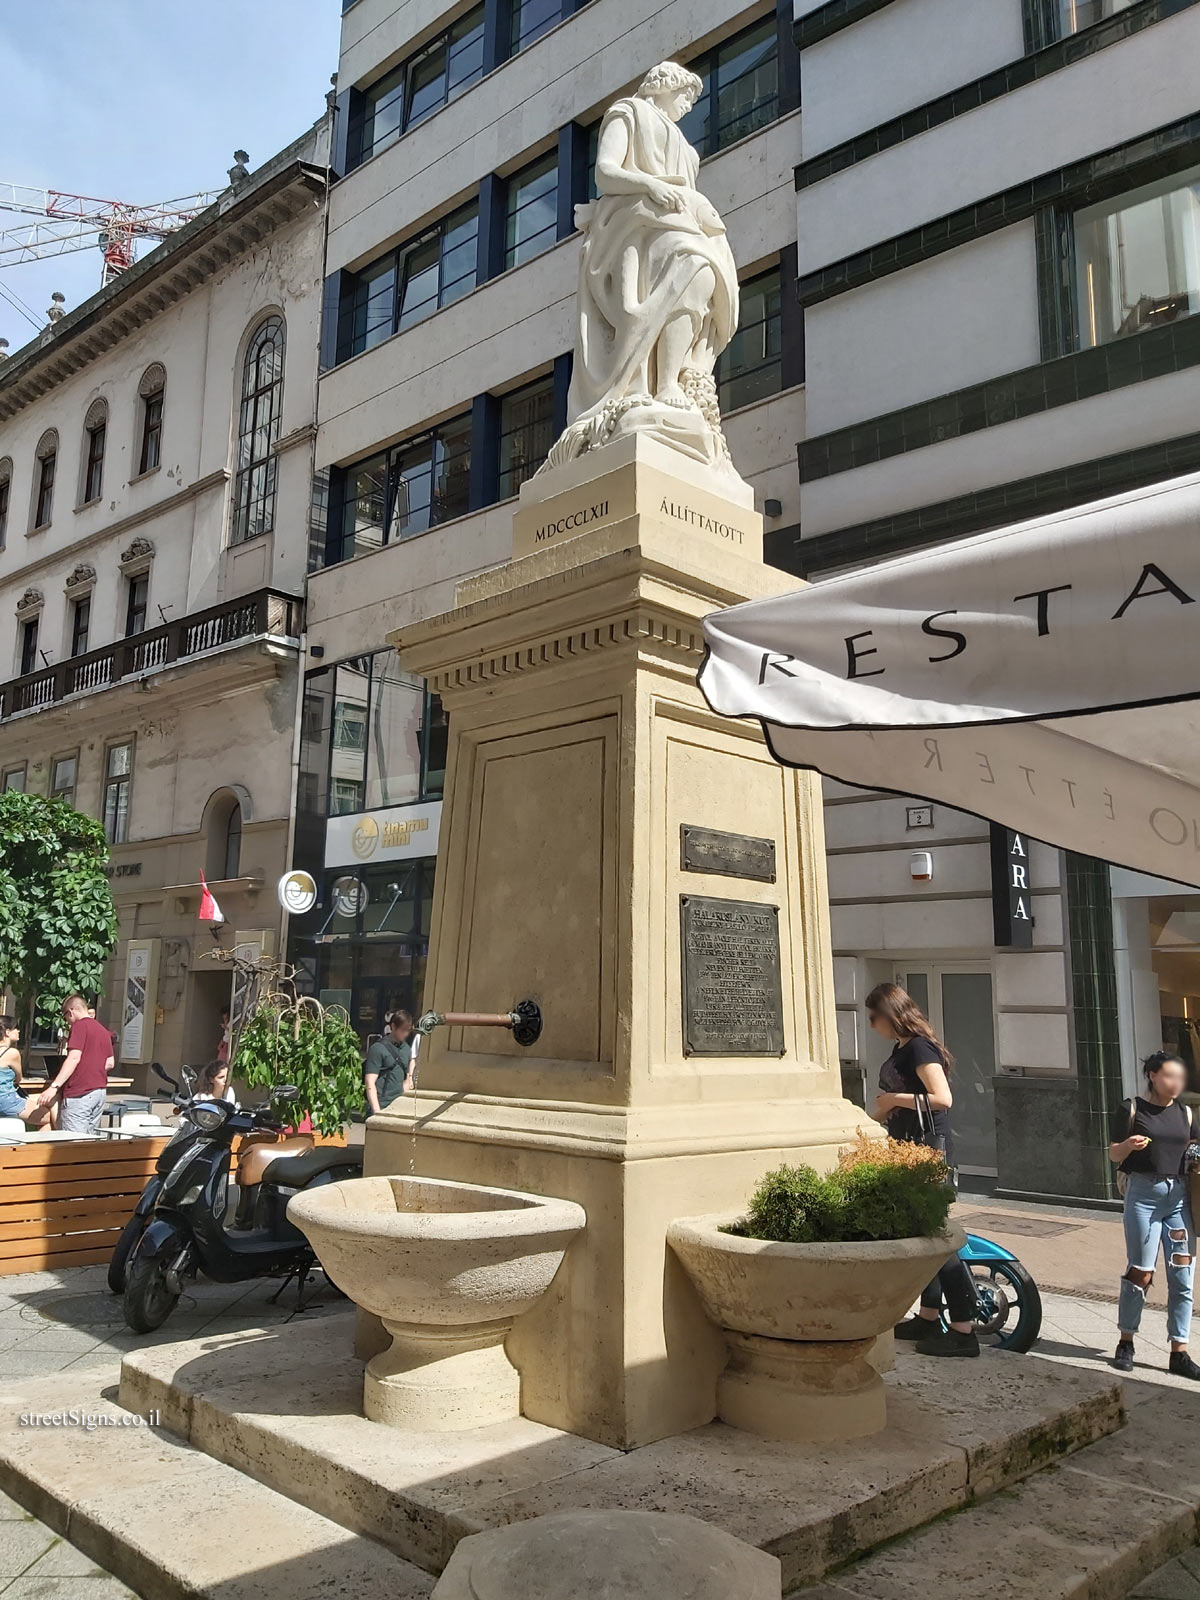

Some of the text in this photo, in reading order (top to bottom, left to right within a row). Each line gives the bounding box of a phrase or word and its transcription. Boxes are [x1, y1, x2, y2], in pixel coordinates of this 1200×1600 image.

[535, 500, 609, 543] MDCCCLXII
[660, 497, 744, 545] ÁLLÍTTATOTT
[758, 562, 1196, 685] RESTA
[381, 832, 410, 849] mini
[916, 814, 922, 824] 2
